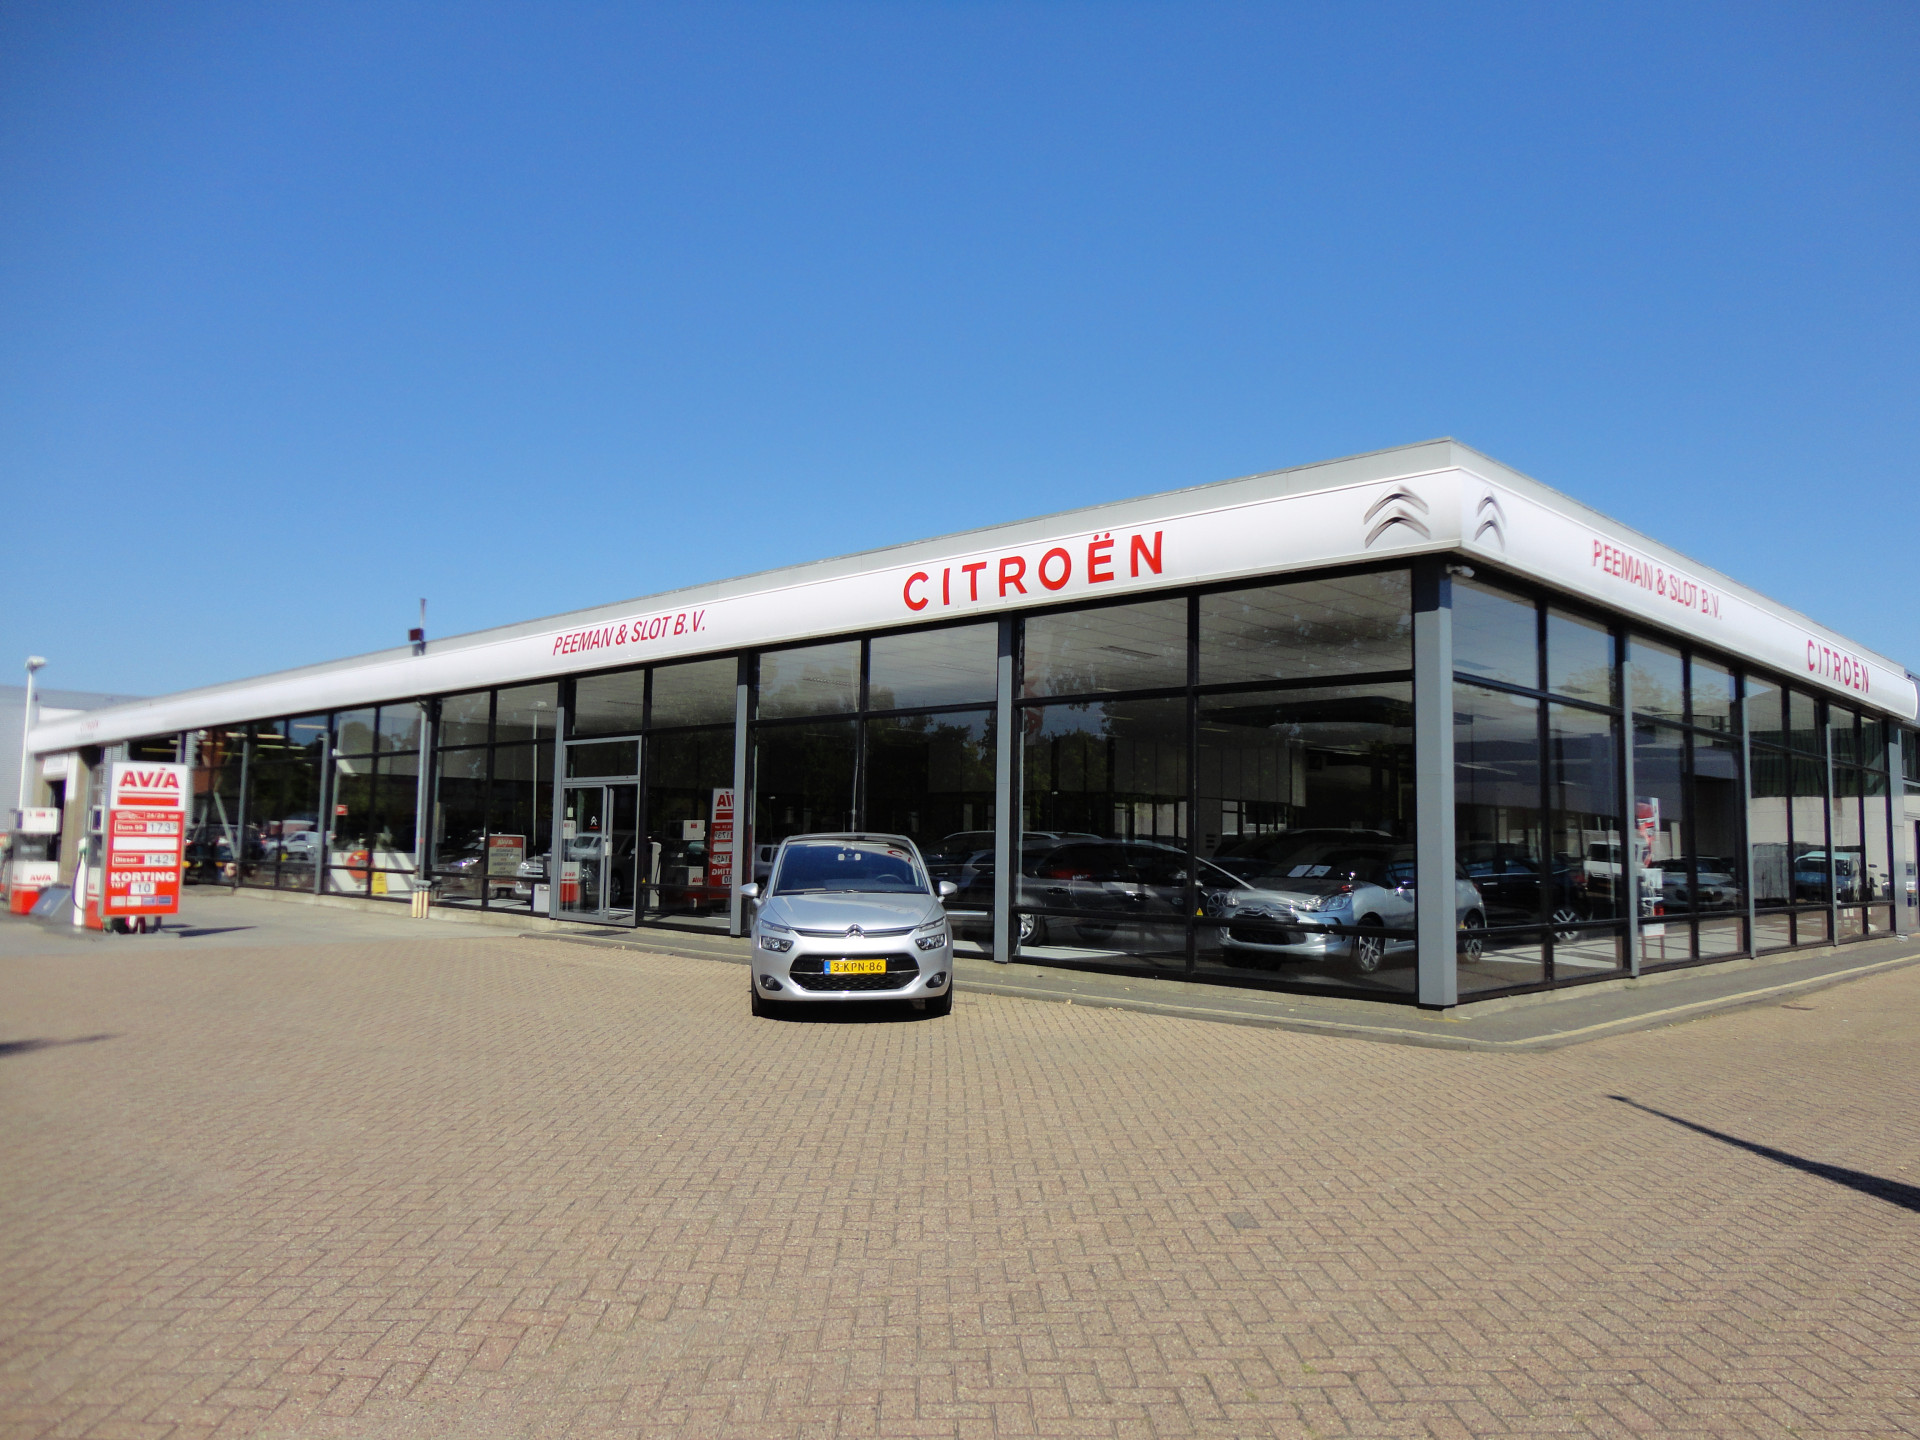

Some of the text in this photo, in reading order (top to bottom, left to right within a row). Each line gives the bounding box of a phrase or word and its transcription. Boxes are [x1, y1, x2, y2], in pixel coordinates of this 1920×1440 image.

[903, 531, 1163, 611] CITROËN
[1592, 538, 1653, 591] PEEMAN
[1656, 567, 1667, 595] &
[1669, 573, 1698, 610] SLOT
[552, 626, 615, 656] PEEMAN
[615, 623, 628, 646] &
[631, 615, 672, 643] SLOT
[1807, 639, 1870, 694] CITROËN
[111, 871, 177, 882] KORTING
[137, 883, 151, 893] 10
[833, 961, 882, 972] 3-KPN-86
